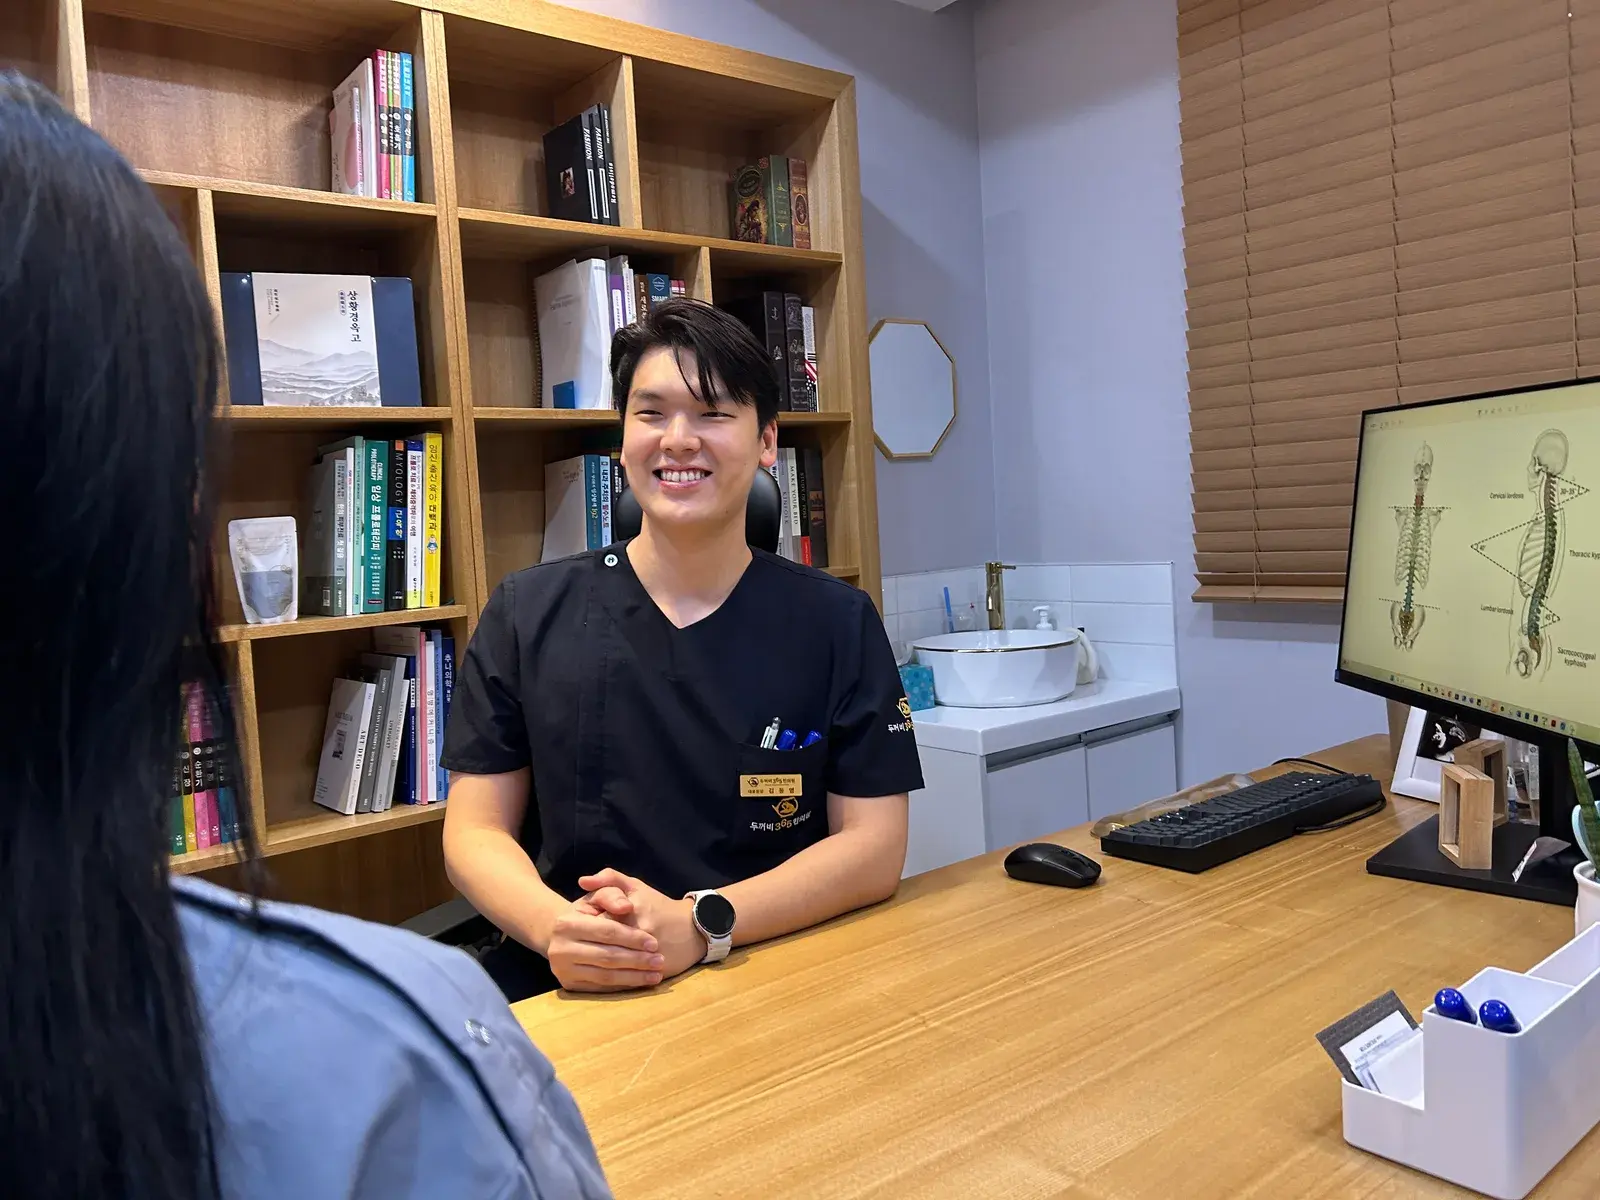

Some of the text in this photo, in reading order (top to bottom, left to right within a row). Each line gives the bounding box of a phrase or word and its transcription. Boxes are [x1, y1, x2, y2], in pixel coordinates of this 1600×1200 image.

[583, 127, 593, 161] FASHION
[595, 126, 605, 160] FASHION
[394, 453, 404, 504] MYOLOGY
[602, 470, 608, 482] 내과
[371, 485, 382, 502] 임상
[370, 505, 381, 550] 프롤로테라피
[1569, 550, 1590, 558] Thoracic
[1557, 647, 1597, 660] Sacrococcygeal
[1564, 658, 1587, 668] kyphosis
[356, 748, 364, 770] DECO
[194, 760, 203, 787] 순환기
